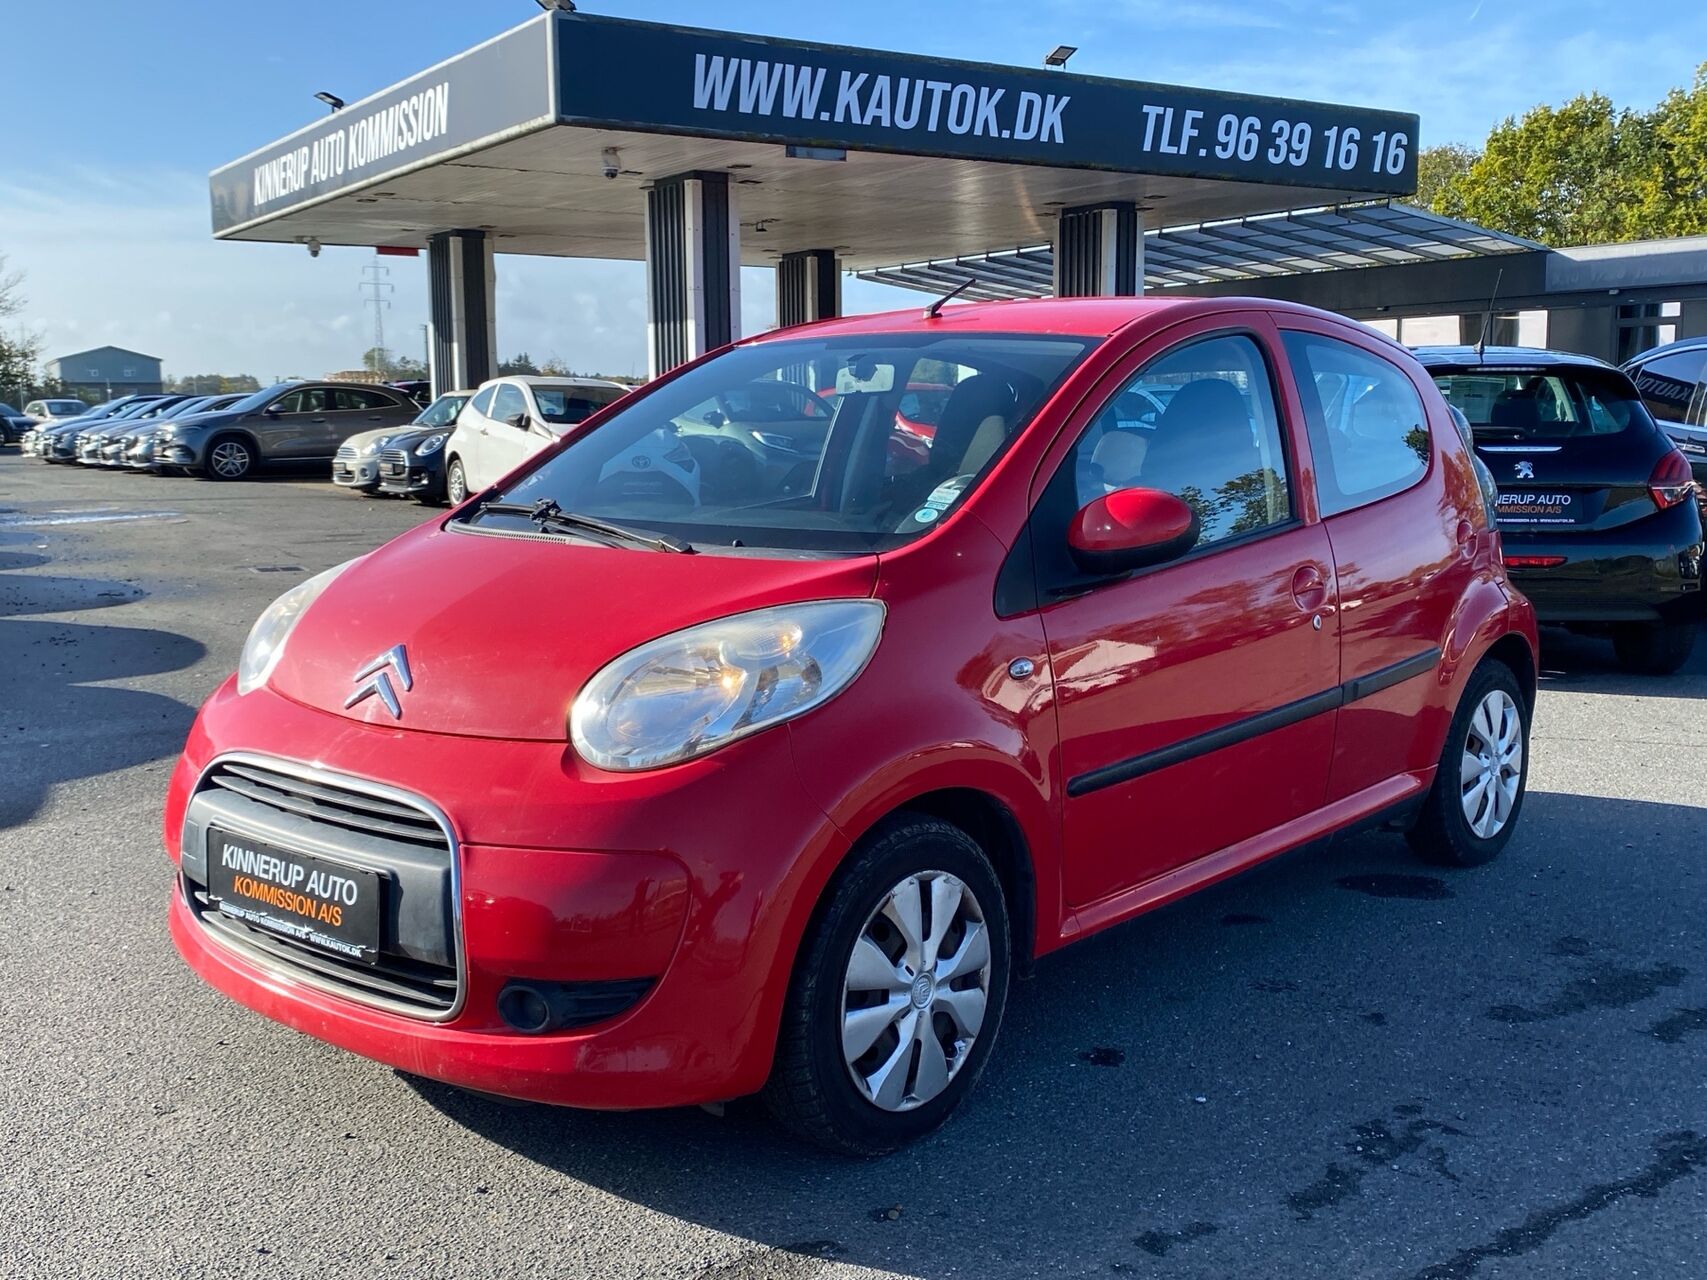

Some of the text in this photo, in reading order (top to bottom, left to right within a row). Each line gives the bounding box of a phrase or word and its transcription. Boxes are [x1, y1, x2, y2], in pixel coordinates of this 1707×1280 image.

[693, 53, 1071, 144] WWW.KAUTOK.DK
[254, 82, 449, 206] KINNERUP AUTO KOMMISSION
[1142, 104, 1408, 175] TLF. 96 39 16 16
[1497, 494, 1571, 505] ERUP AUTO
[1497, 505, 1562, 514] MMISSION A/S
[222, 843, 358, 906] KINNERUP AUTO
[234, 875, 342, 927] KOMMISSION A/S
